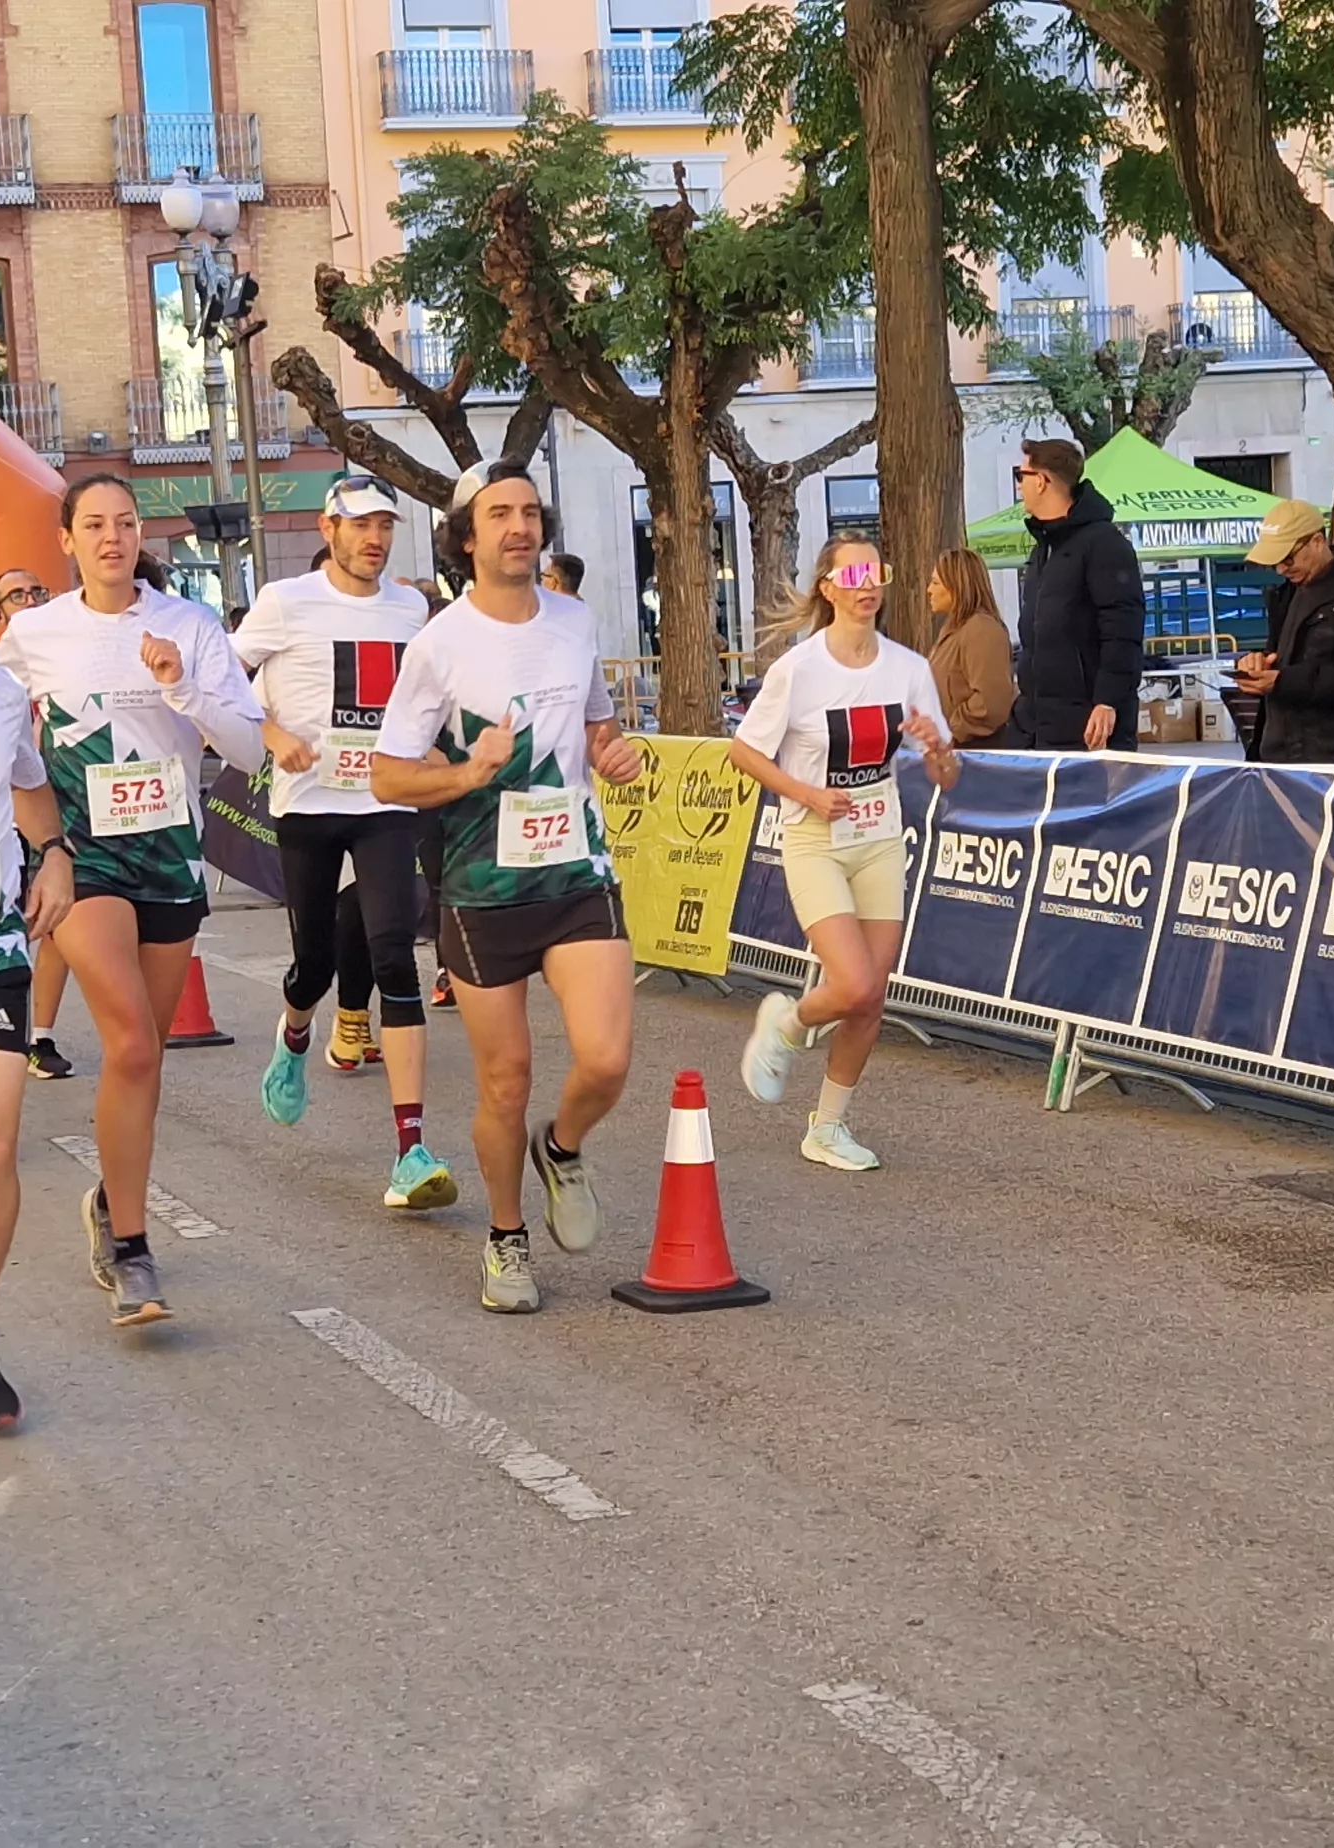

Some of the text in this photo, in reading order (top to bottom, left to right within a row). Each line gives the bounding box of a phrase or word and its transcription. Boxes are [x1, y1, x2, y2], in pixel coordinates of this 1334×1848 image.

[1136, 489, 1231, 501] FARTLECK
[1149, 500, 1240, 512] SPORT
[1142, 519, 1264, 548] AVITUALLAMIENTO
[111, 778, 165, 804] 573
[110, 801, 168, 816] CRISTINA
[848, 800, 885, 822] 519
[522, 813, 571, 840] 572
[533, 839, 563, 851] JUAN
[954, 833, 1024, 889] ESIC
[1068, 848, 1151, 909] ESIC
[1206, 864, 1296, 929] ESIC
